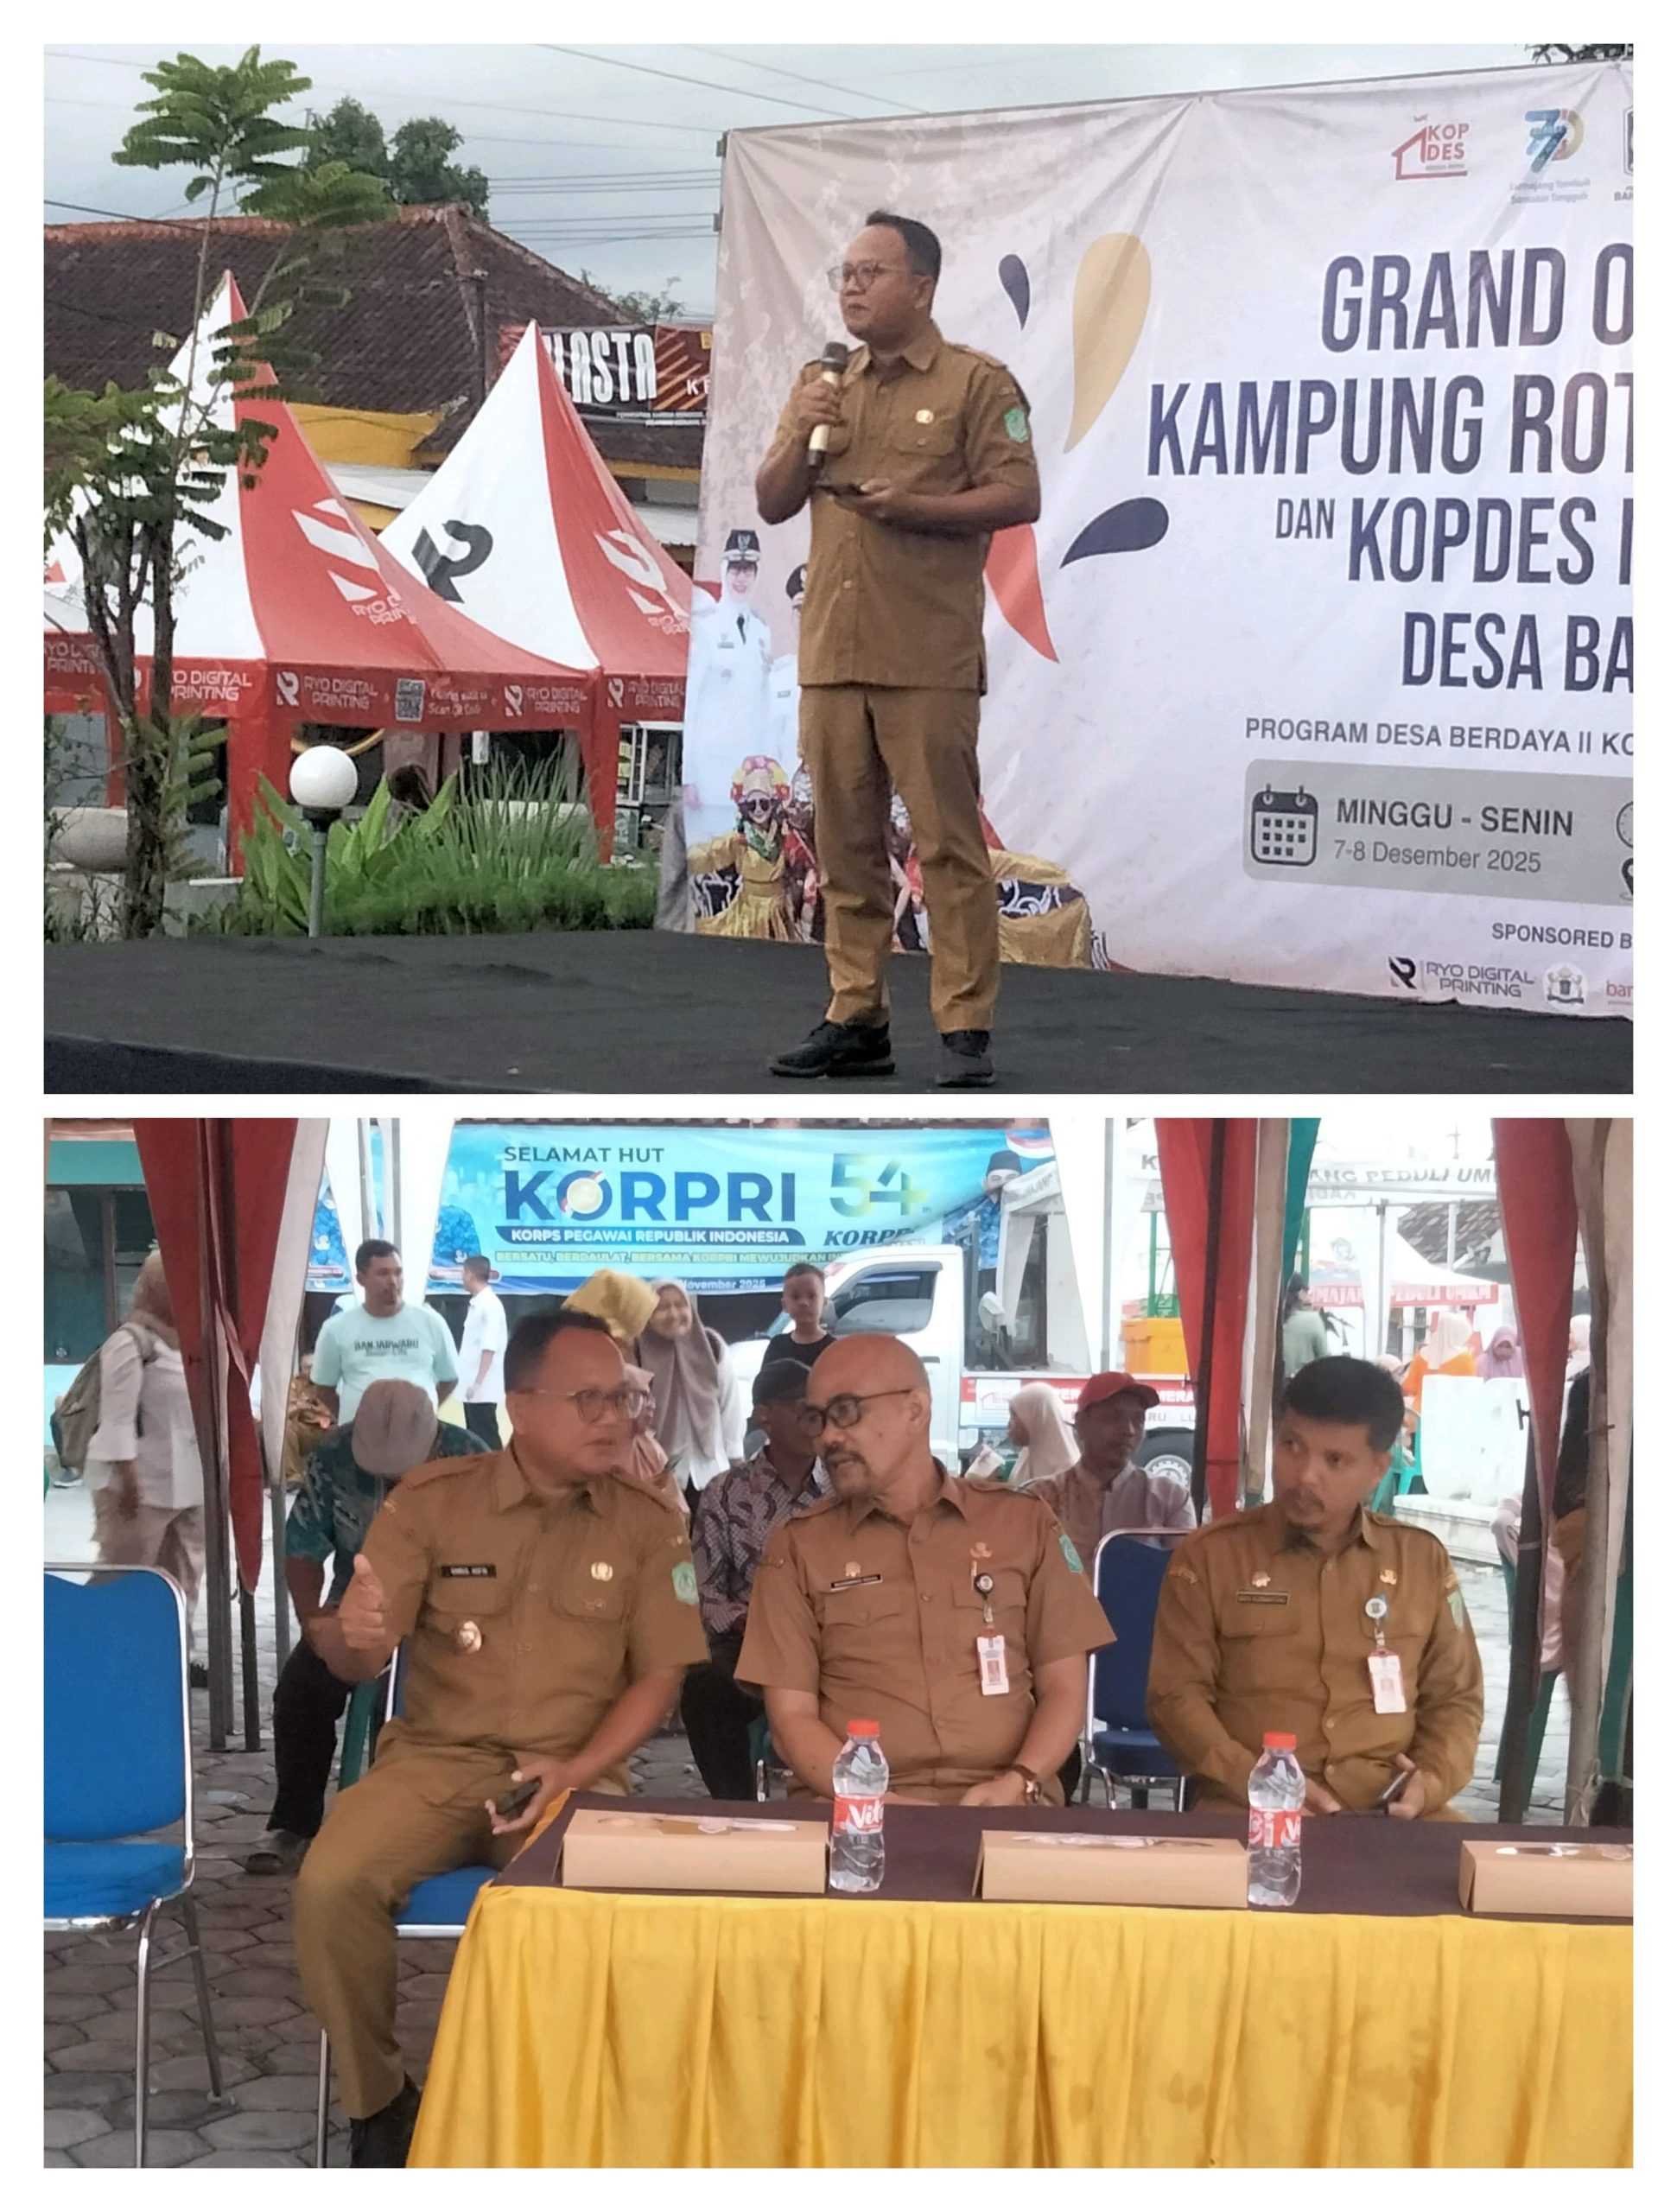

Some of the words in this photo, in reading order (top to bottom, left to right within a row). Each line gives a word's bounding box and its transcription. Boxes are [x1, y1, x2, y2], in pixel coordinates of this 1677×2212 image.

[1427, 123, 1470, 142] KOP
[1426, 142, 1465, 162] DES
[1321, 247, 1566, 353] GRAND
[1592, 243, 1633, 346] O
[1147, 375, 1485, 476] KAMPUNG
[1276, 498, 1336, 540] DAN
[1348, 497, 1598, 586] KOPDES
[1401, 612, 1544, 691] DESA
[1564, 615, 1633, 694] BA
[190, 671, 253, 688] DIGITAL
[304, 676, 330, 692] RYO
[332, 678, 378, 697] DIGITAL
[312, 691, 370, 709] PRINTING
[1245, 717, 1369, 744] PROGRAM
[1375, 724, 1442, 747] DESA
[1449, 726, 1571, 753] BERDAYA
[1337, 798, 1453, 830] MINGGU
[1480, 806, 1574, 836] SENIN
[1334, 839, 1366, 861] 7-8
[1372, 841, 1481, 868] Desember
[1487, 849, 1542, 873] 2025
[1491, 923, 1614, 949] SPONSORED
[1620, 932, 1633, 950] B
[1426, 960, 1464, 977] RYO
[1468, 965, 1536, 985] DIGITAL
[1439, 977, 1522, 998] PRINTING
[504, 1146, 612, 1163] SELAMAT
[619, 1147, 664, 1163] HUT
[1366, 1168, 1450, 1182] PEDULI
[1458, 1168, 1496, 1183] UM
[505, 1170, 796, 1222] KORPRI
[829, 1153, 929, 1218] 54
[511, 1229, 562, 1242] KORPS
[563, 1229, 632, 1243] PEGAWAI
[635, 1230, 707, 1243] REPUBLIK
[709, 1230, 790, 1243] INDONESIA
[631, 1251, 690, 1263] BERSAMA
[692, 1251, 739, 1264] KORPRI
[740, 1251, 827, 1264] MEWUJUDKAN
[681, 1278, 737, 1291] November
